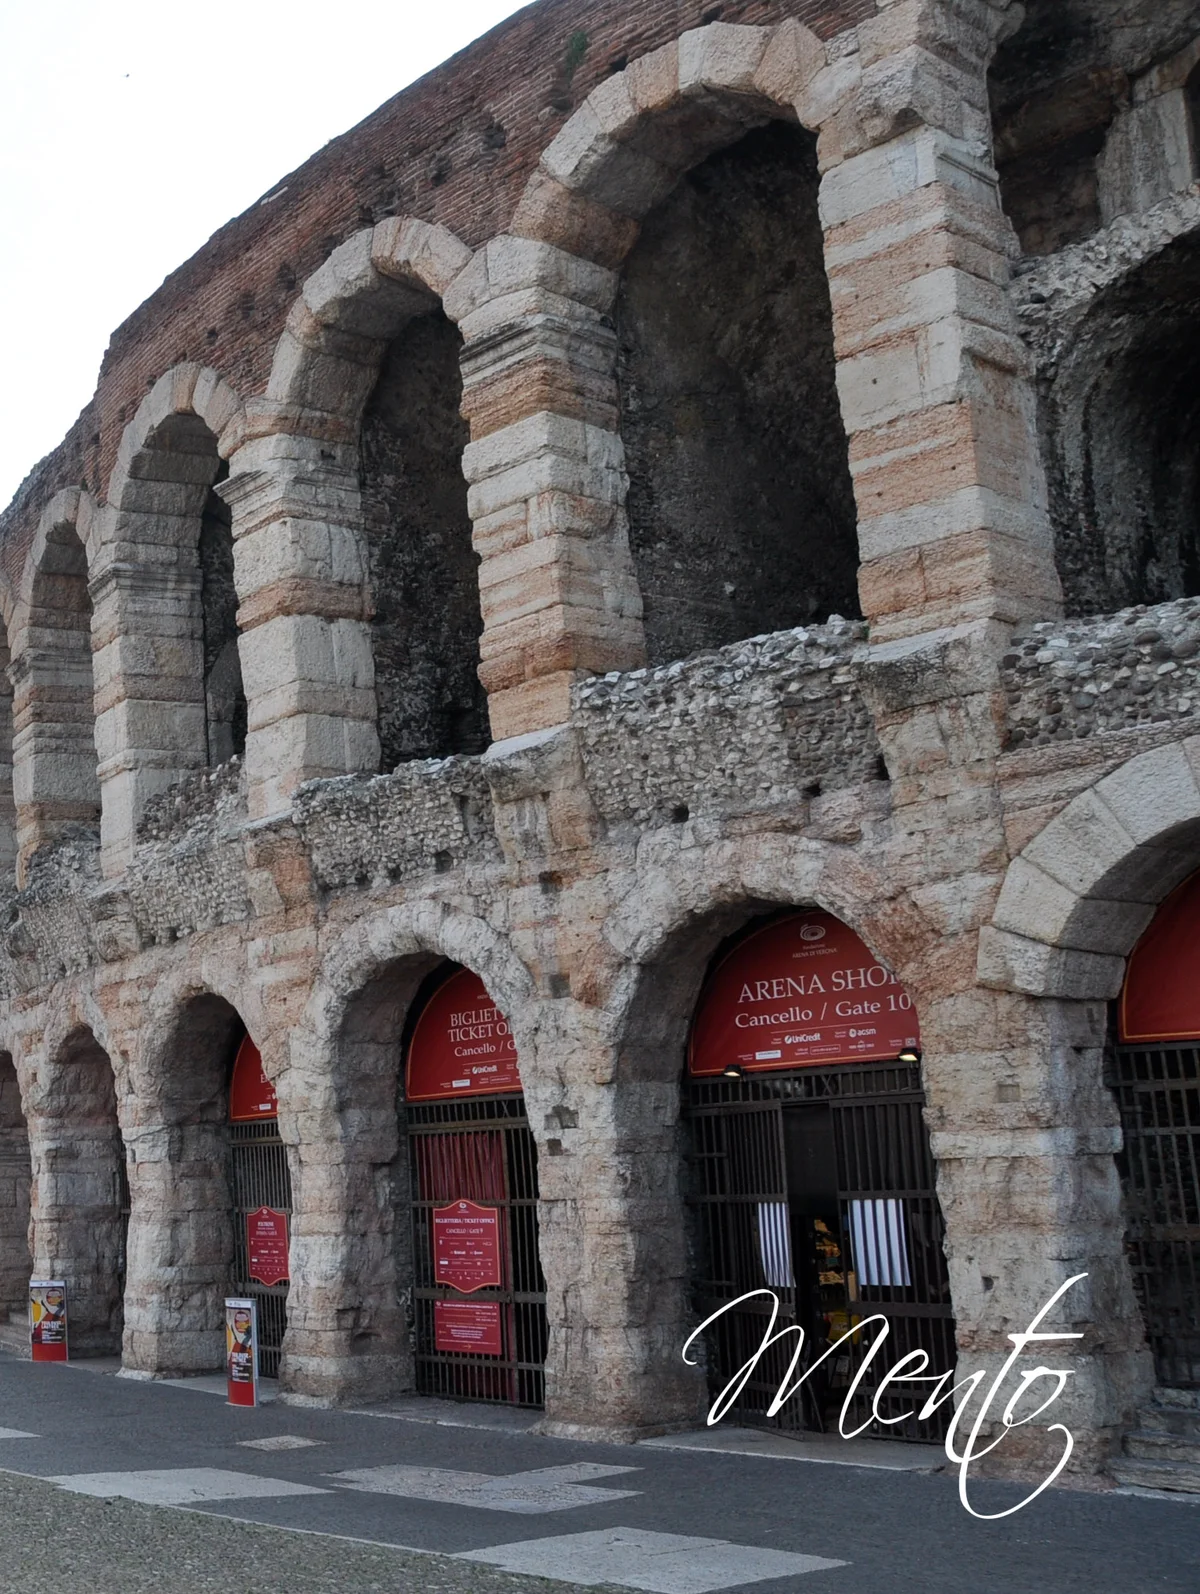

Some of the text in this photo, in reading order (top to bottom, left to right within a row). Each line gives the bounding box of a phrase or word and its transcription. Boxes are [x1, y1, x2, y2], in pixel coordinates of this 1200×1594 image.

[816, 948, 838, 956] VERONA
[737, 974, 826, 1004] ARENA
[450, 1007, 506, 1027] BIGLIET
[735, 1006, 813, 1028] Cancello
[835, 1000, 881, 1017] Gate
[886, 993, 912, 1012] 10
[447, 1023, 494, 1043] TICKET
[792, 1032, 820, 1044] UniCredit
[454, 1042, 496, 1057] Cancello
